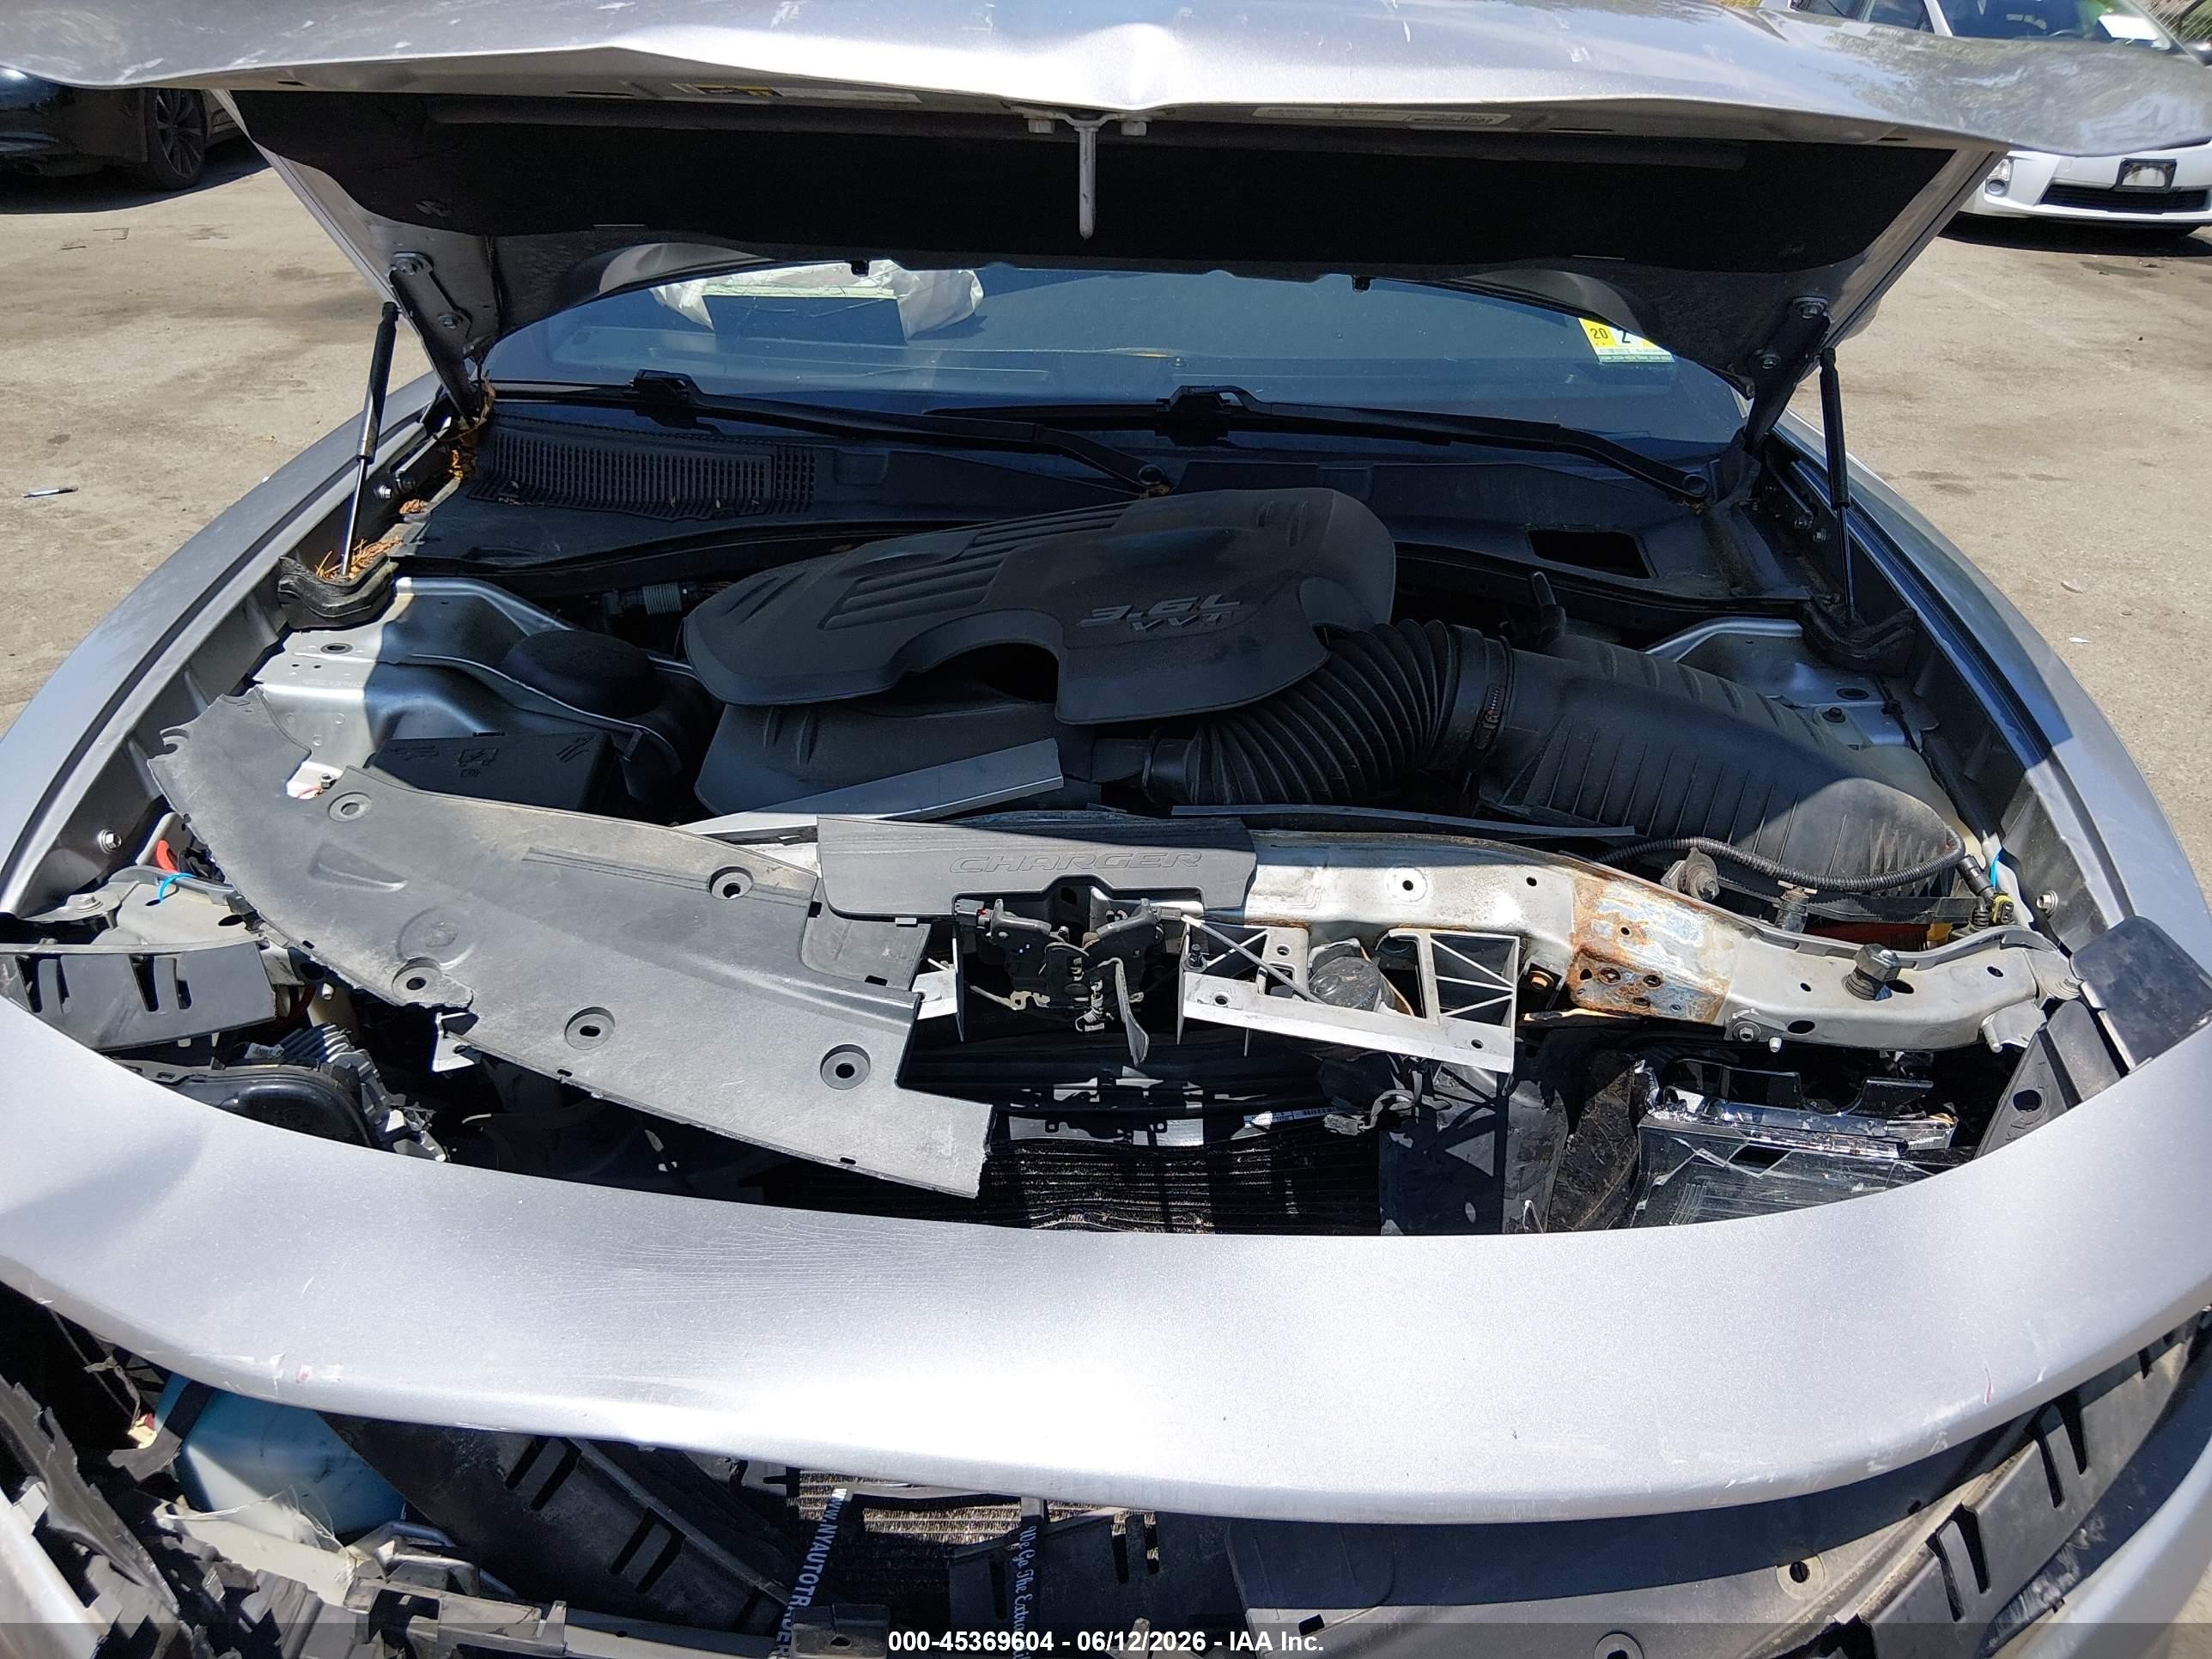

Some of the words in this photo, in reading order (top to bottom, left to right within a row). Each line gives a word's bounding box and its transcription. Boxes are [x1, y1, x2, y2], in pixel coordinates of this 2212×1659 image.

[1589, 328, 1609, 339] 20
[1077, 593, 1241, 629] 3.6L
[1131, 611, 1235, 632] VVT
[949, 852, 1203, 873] CHARGER
[1019, 1525, 1037, 1549] We
[1012, 1549, 1036, 1569] Go
[1015, 1569, 1034, 1594] The
[1013, 1594, 1033, 1632] Extra
